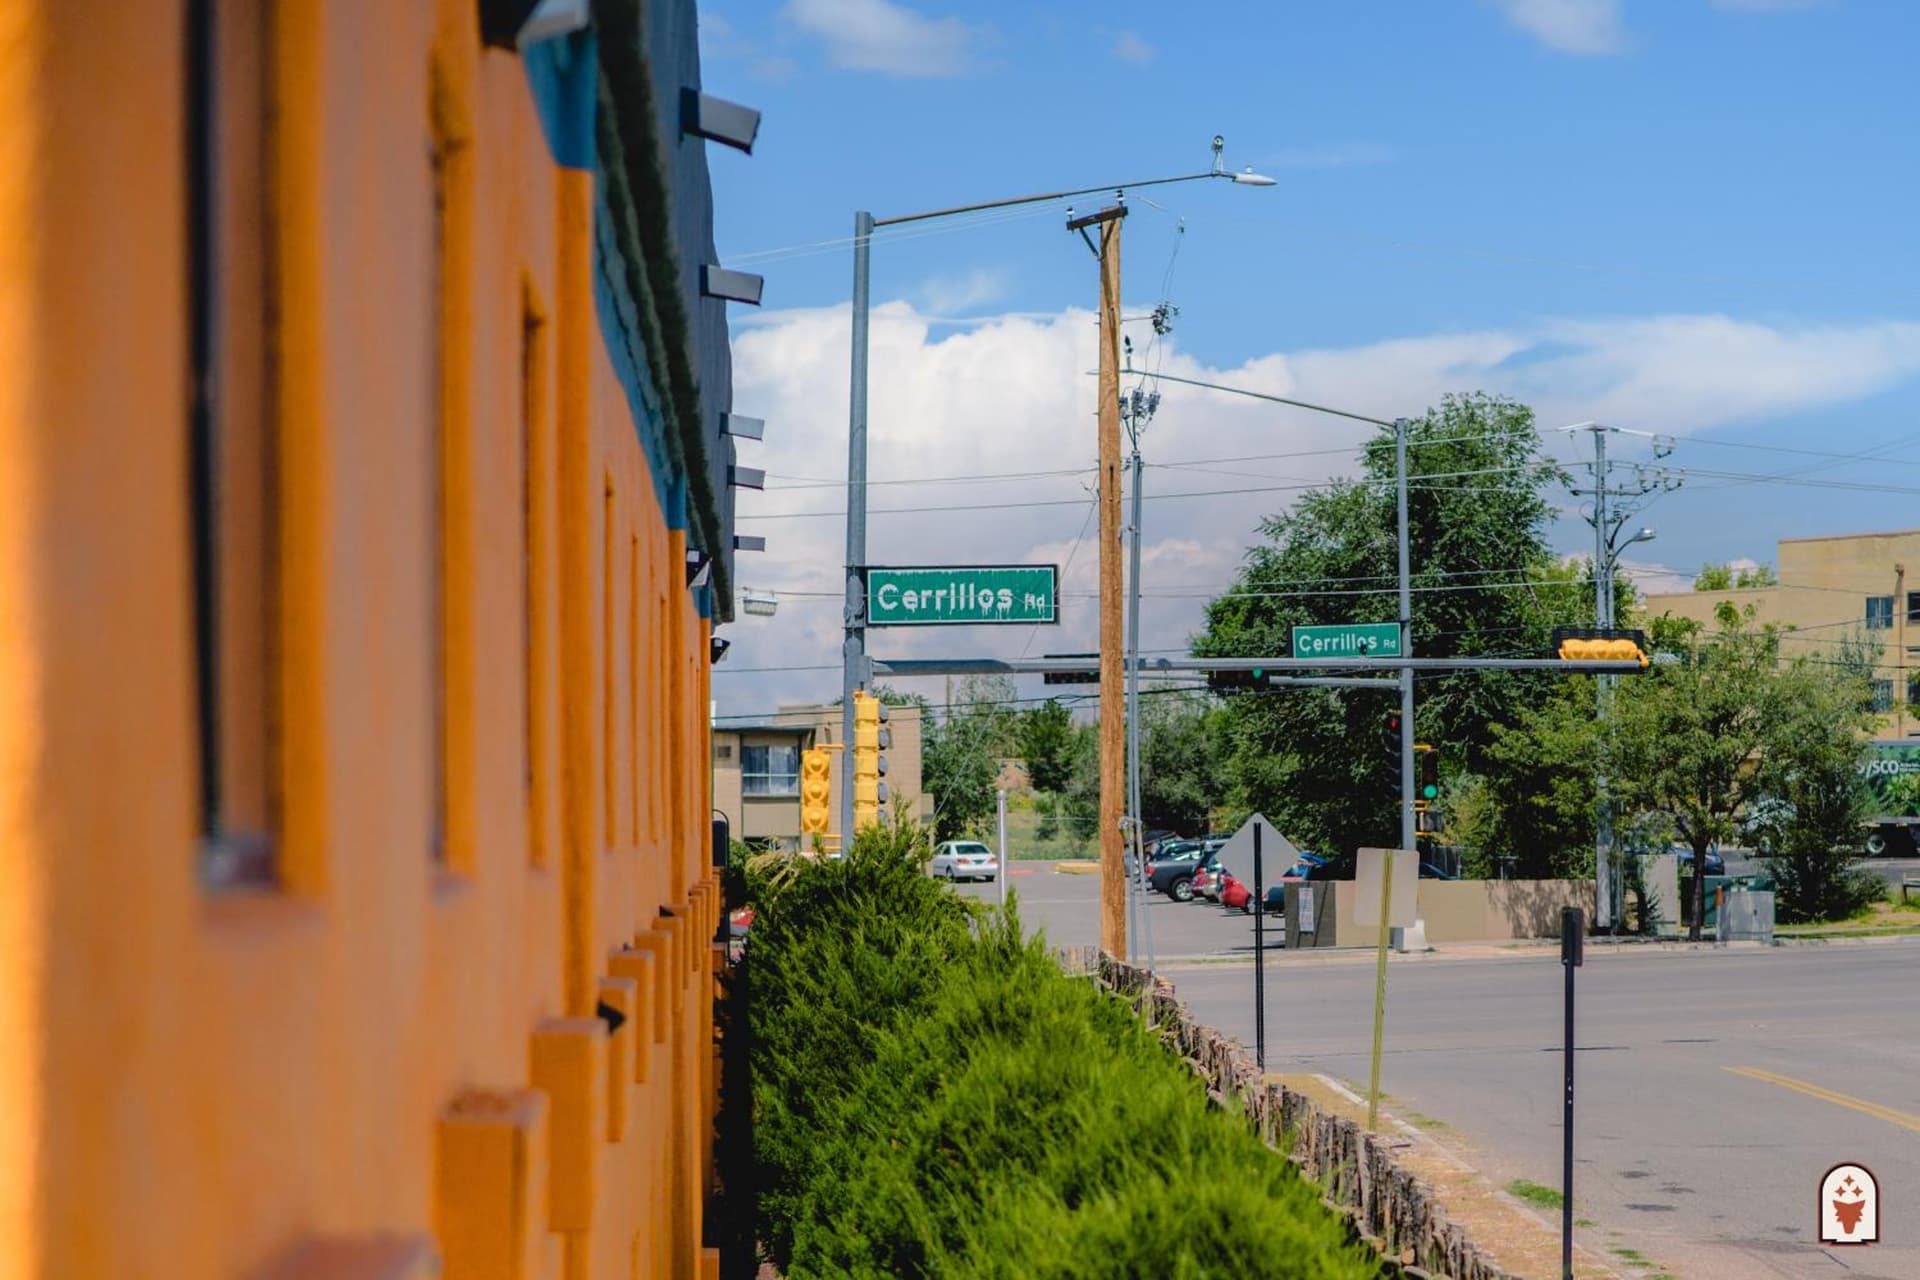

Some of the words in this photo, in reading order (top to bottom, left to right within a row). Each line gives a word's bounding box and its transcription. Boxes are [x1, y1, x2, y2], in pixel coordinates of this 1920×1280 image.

[878, 582, 1012, 614] Cerrillos
[1024, 592, 1045, 612] Rd
[1299, 633, 1377, 652] Cerrillos
[1383, 639, 1396, 649] Rd
